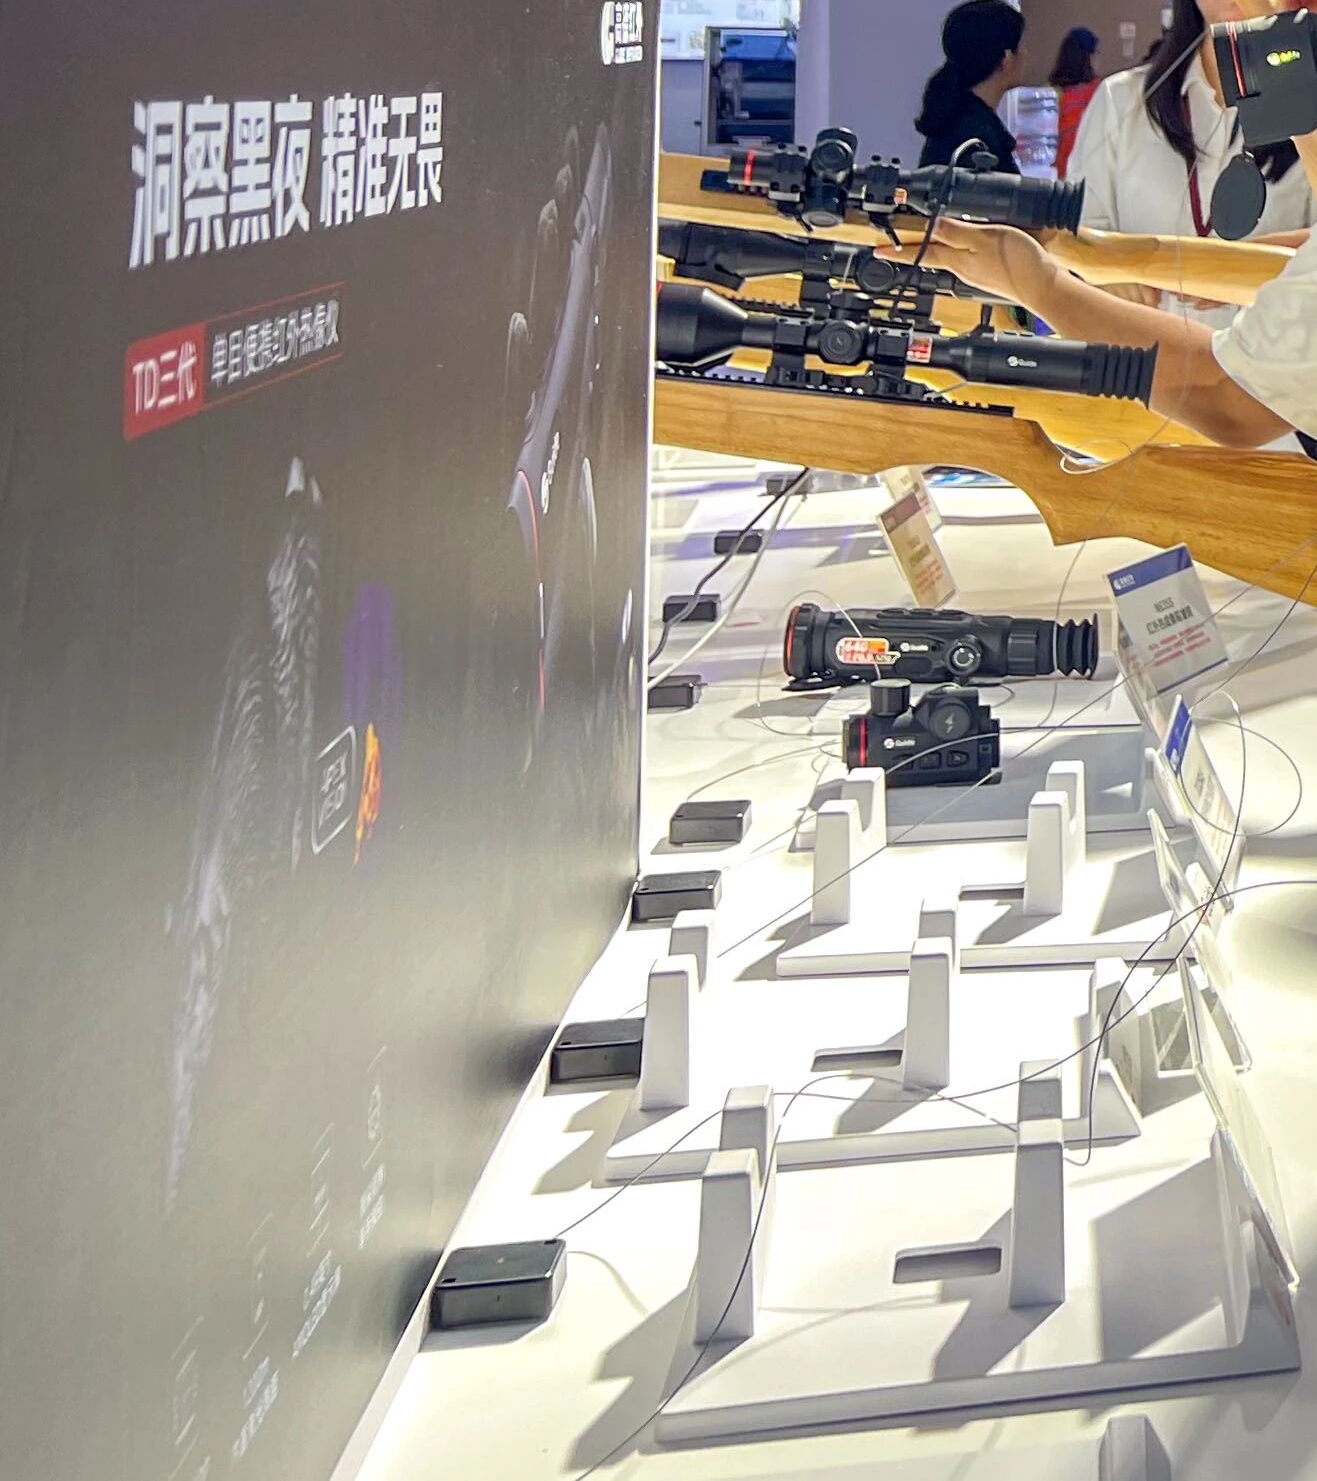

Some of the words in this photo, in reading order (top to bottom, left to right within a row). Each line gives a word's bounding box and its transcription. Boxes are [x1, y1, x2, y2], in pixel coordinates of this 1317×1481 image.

[128, 93, 314, 270] 洞察黑夜
[320, 92, 443, 228] 精准无畏
[132, 342, 198, 415] TD三代
